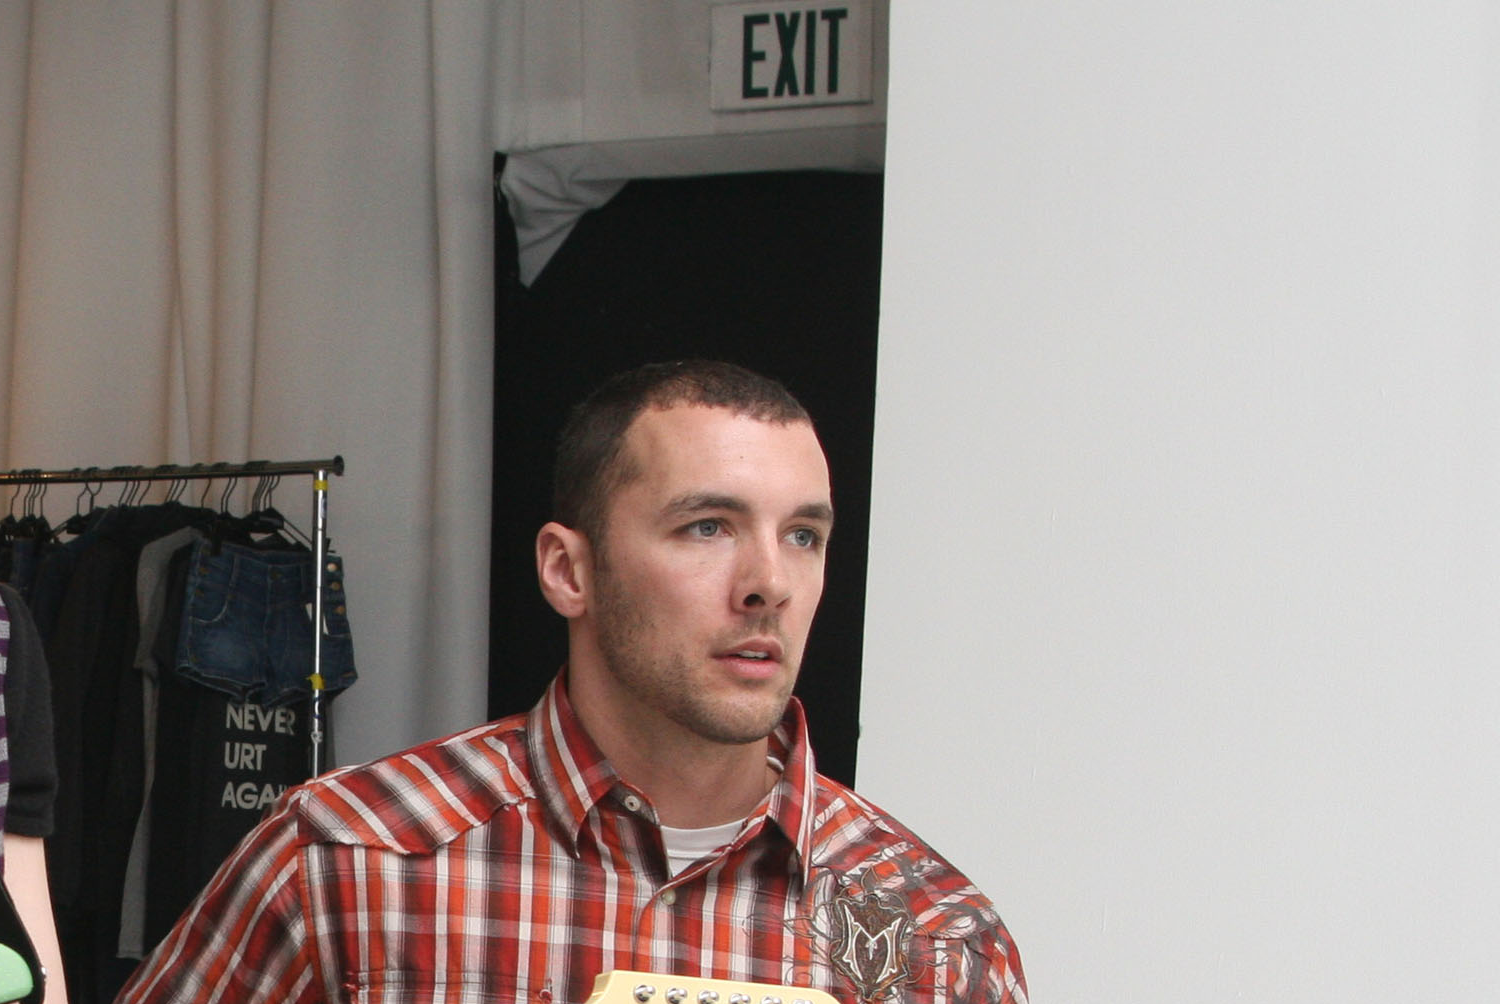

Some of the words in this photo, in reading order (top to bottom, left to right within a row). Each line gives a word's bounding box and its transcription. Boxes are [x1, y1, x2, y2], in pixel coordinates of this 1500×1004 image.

[742, 8, 848, 98] EXIT
[226, 703, 296, 735] NEVER
[224, 742, 267, 771] URT
